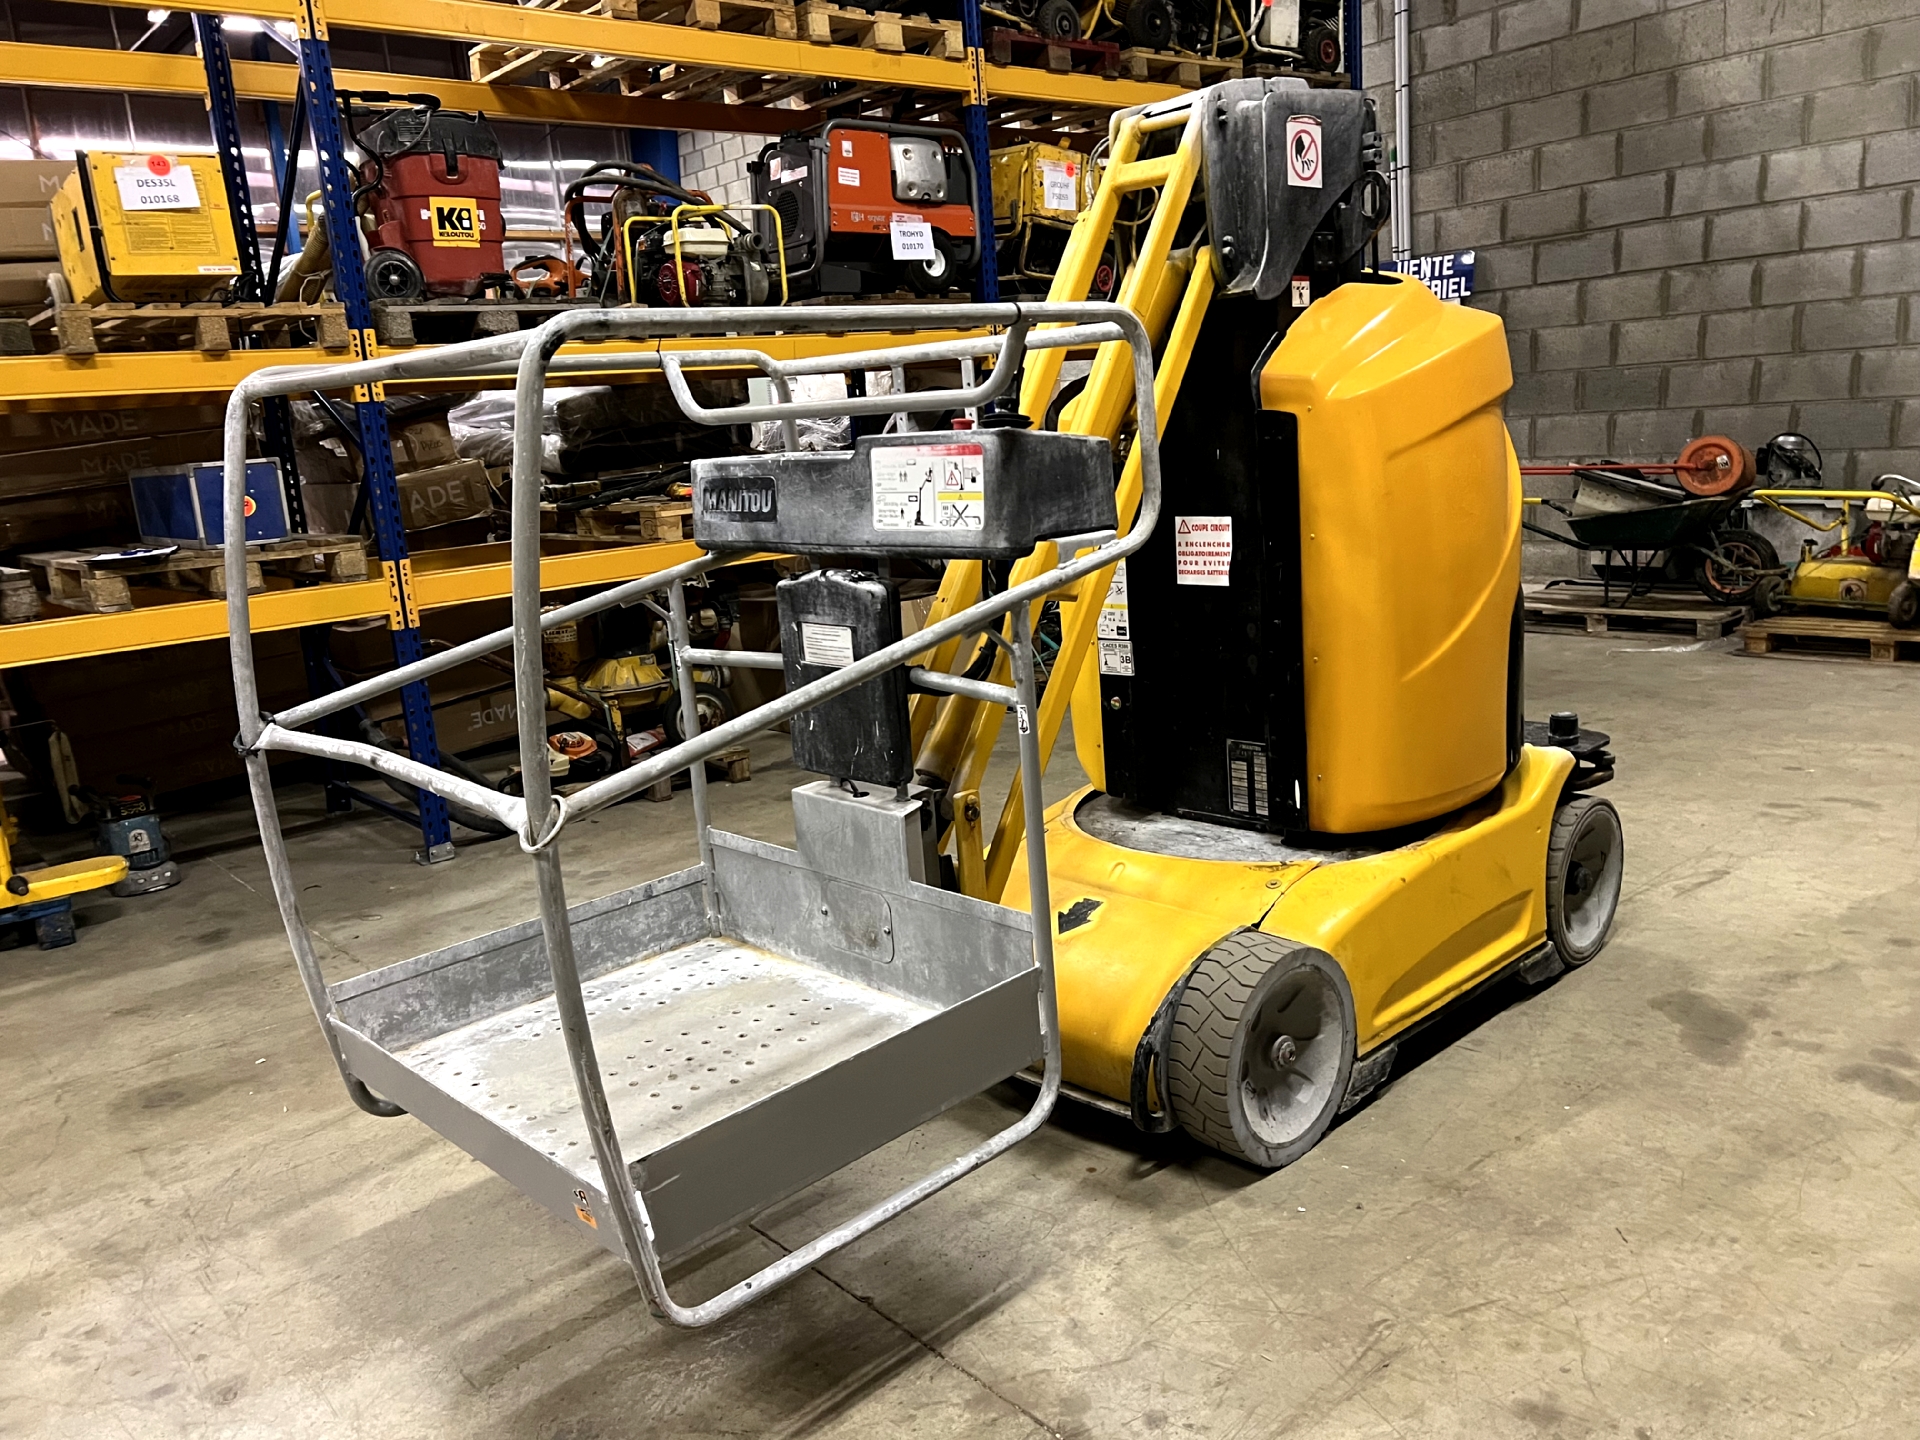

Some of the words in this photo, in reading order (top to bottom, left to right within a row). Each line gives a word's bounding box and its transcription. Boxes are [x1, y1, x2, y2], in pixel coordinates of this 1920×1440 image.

[136, 179, 177, 188] DES35L
[140, 195, 180, 204] 010168
[51, 410, 139, 438] MADE
[80, 450, 154, 476] MADE
[410, 480, 465, 513] ADE
[703, 489, 772, 513] MANITOU
[1191, 524, 1209, 532] COUPE
[1210, 524, 1230, 532] CIRCUIT
[1120, 656, 1132, 665] 3B
